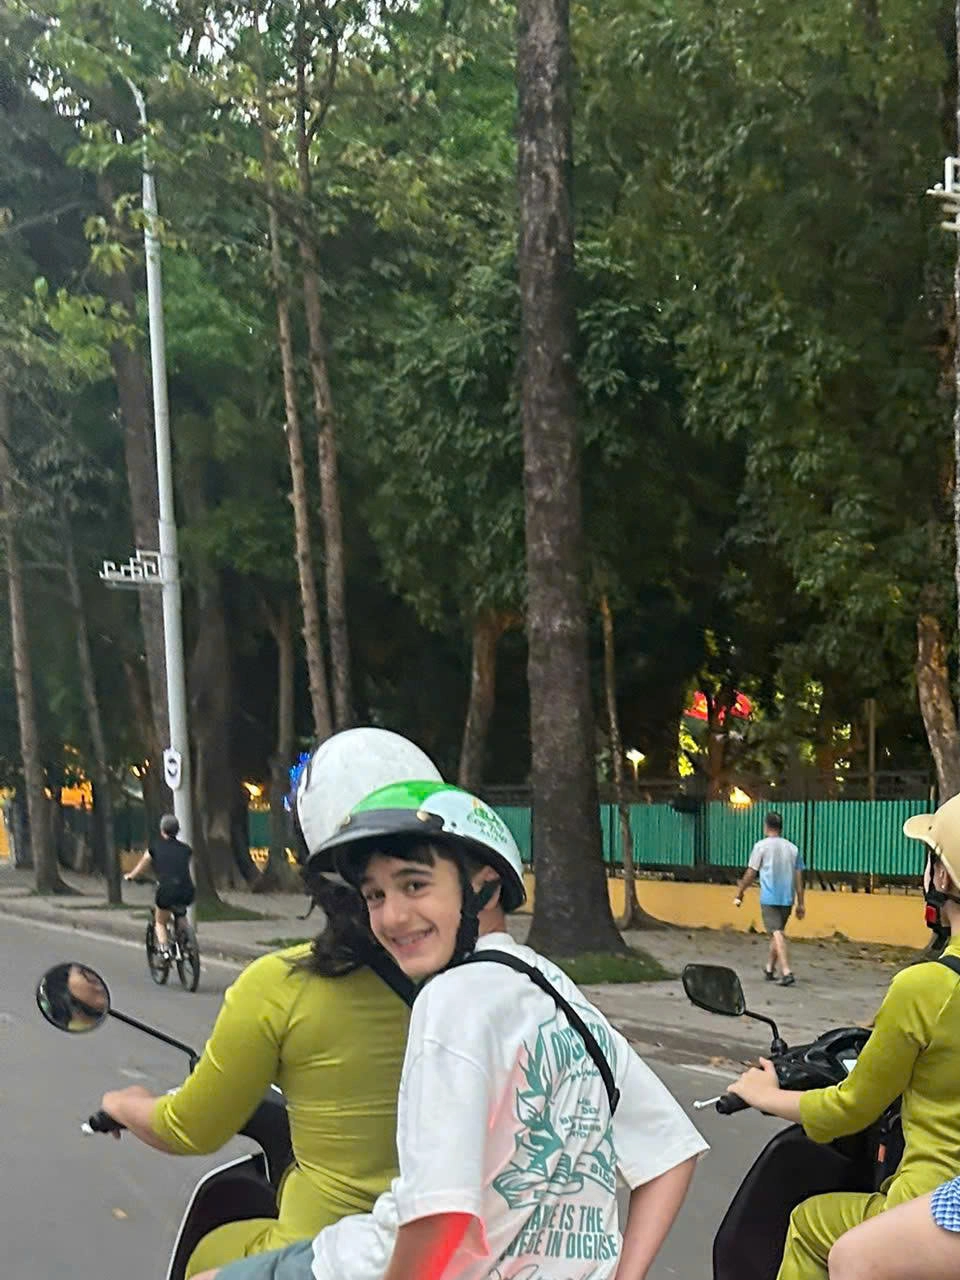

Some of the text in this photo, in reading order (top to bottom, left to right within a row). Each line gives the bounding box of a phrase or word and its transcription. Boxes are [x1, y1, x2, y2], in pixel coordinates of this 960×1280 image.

[559, 1203, 575, 1231] IS
[579, 1206, 605, 1233] THE
[544, 1230, 563, 1258] IN
